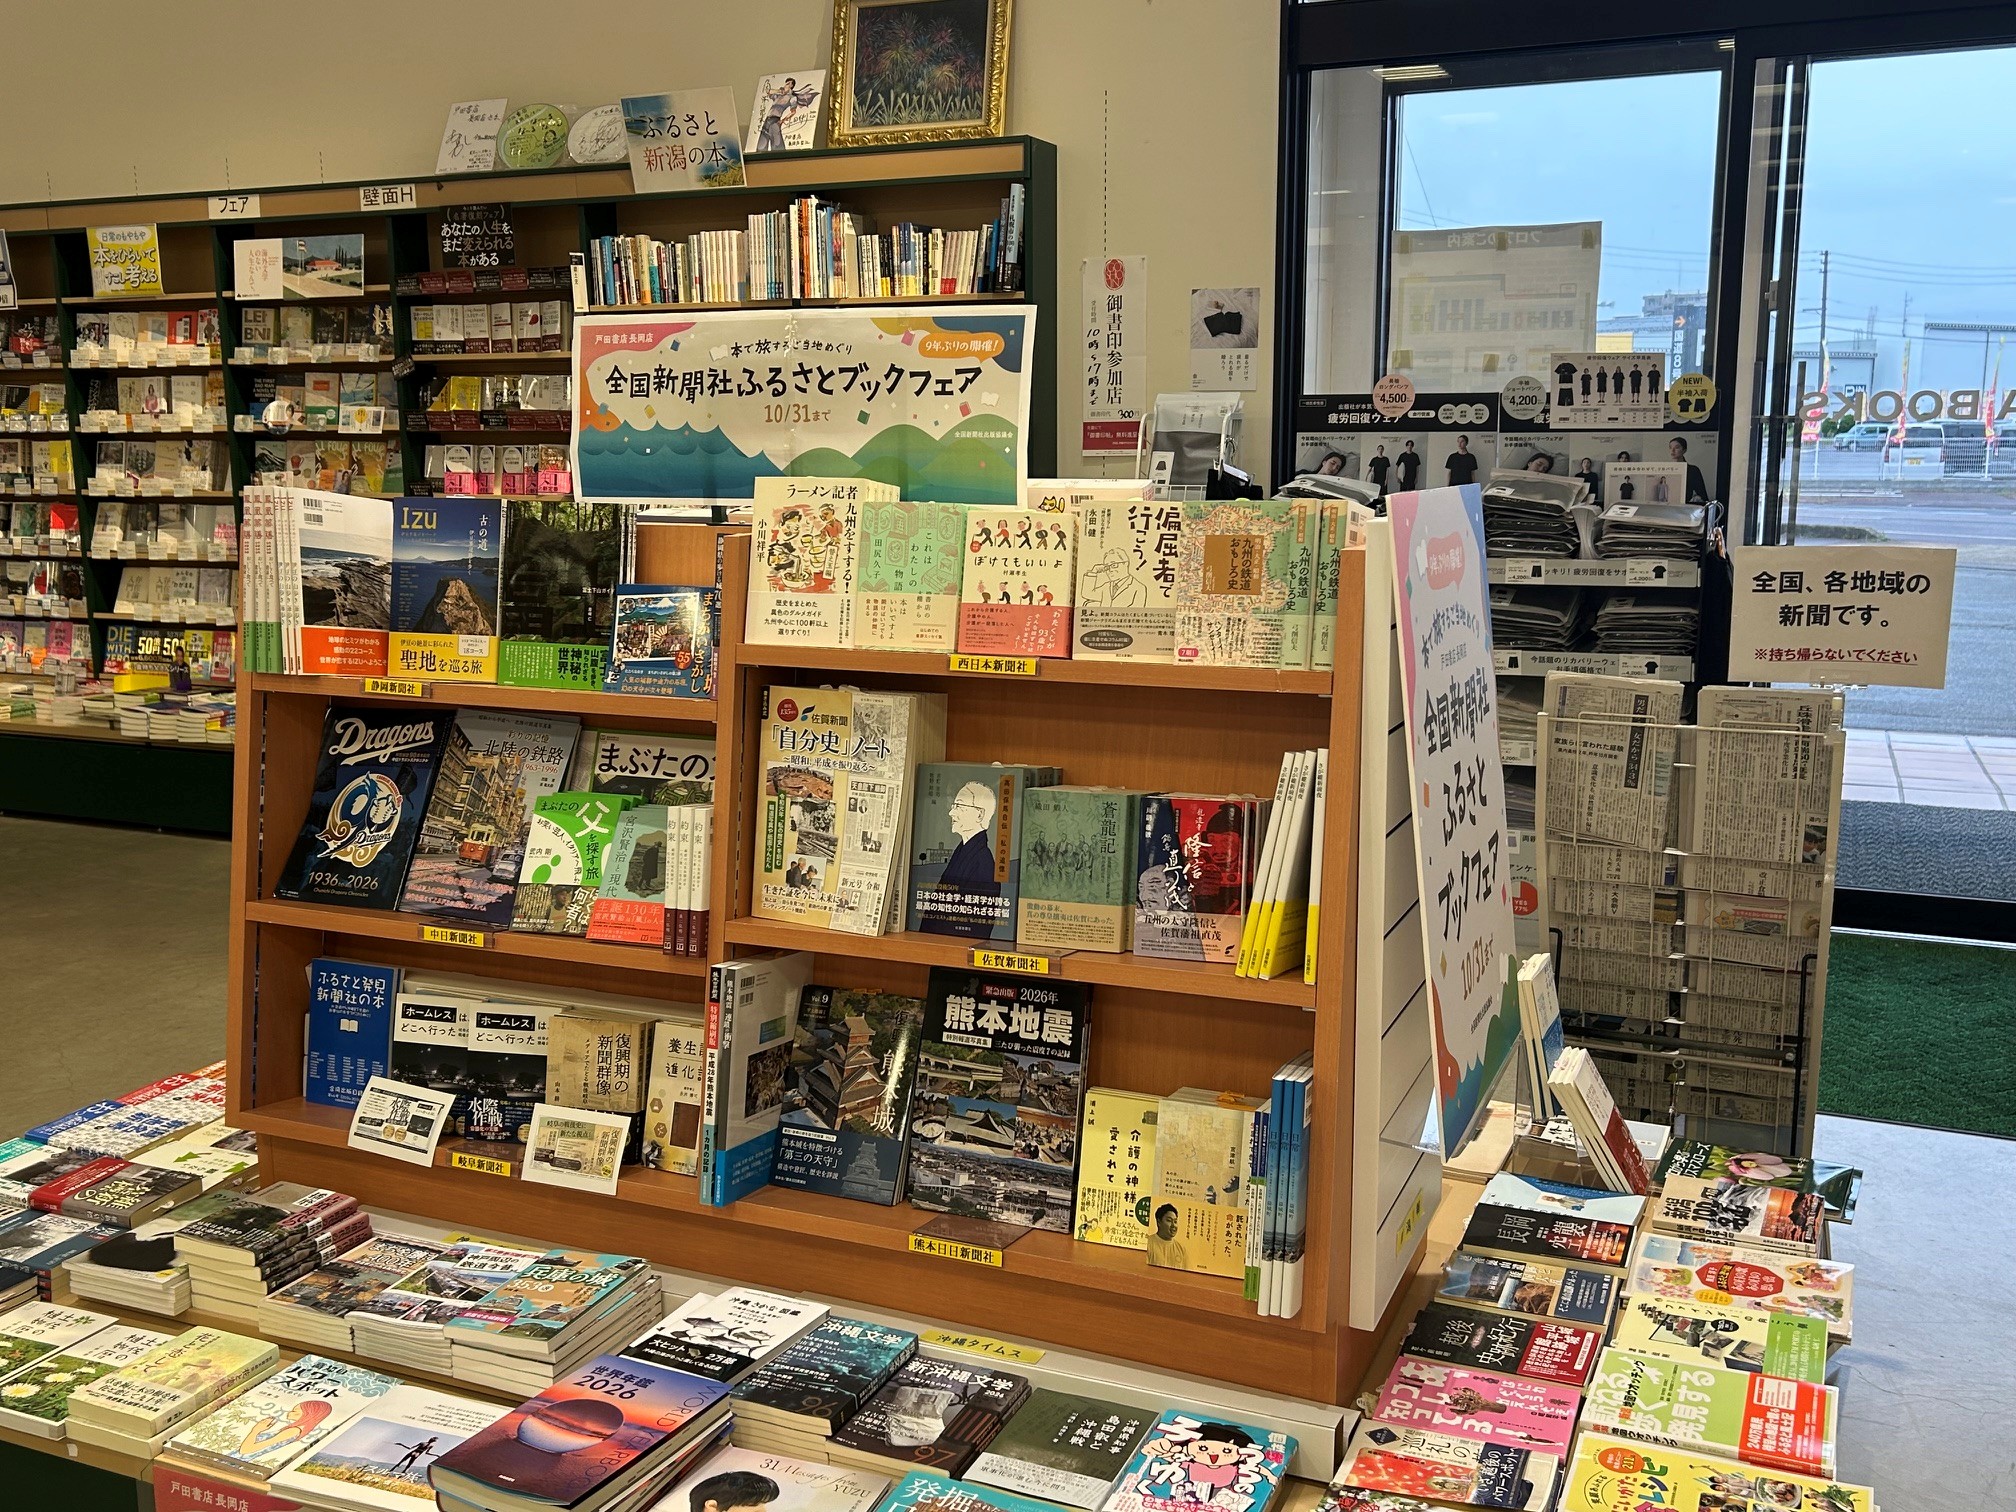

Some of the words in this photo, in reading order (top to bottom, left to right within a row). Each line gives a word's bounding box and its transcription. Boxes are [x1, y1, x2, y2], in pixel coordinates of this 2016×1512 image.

[642, 110, 720, 139] ふるさと
[643, 141, 728, 172] 新潟の本
[218, 196, 249, 213] フェア
[362, 187, 414, 207] 壁面H
[101, 231, 146, 242] 日常のもやもや
[441, 221, 513, 237] あなたの人生を、
[93, 244, 157, 268] 本をひらいて
[442, 236, 514, 253] まだ変えられる
[457, 252, 500, 267] 本がある
[105, 264, 158, 288] すこし考える
[594, 333, 654, 345] 戸田書店長岡店
[731, 338, 853, 358] 本で旅するご当地めぐり
[925, 339, 999, 353] 9年ぶりの開催!
[1106, 294, 1123, 405] 御書印参加店
[605, 364, 983, 404] 全国新聞社ふるさとブックフェア
[1682, 377, 1703, 385] NEW!
[1380, 393, 1407, 404] 4,500
[1509, 395, 1538, 406] 4,200
[1676, 389, 1708, 398] 半袖入荷
[764, 403, 831, 424] 10/31まで
[1328, 412, 1402, 425] 疲労回復ウェア
[954, 431, 1014, 439] 全国新聞社出版協議会
[786, 484, 859, 500] ラーメン記者
[401, 506, 437, 531] Izu
[1088, 509, 1098, 526] 永田
[478, 515, 489, 551] 古の道
[755, 518, 768, 563] 小川祥平
[1087, 528, 1097, 538] 健
[1127, 505, 1153, 572] 行こう!
[842, 502, 859, 594] 九州をすする!
[872, 539, 883, 580] 田尻久子
[923, 531, 933, 565] これは
[1152, 506, 1182, 598] 偏屈者で
[908, 544, 920, 587] わたしの
[974, 556, 1063, 569] ぼけてもいいよ
[1227, 538, 1241, 591] おもしろ史
[1240, 537, 1254, 591] 九州の鉄道
[1297, 546, 1312, 599] 九州の鉄道
[893, 569, 904, 592] 物語
[1285, 561, 1299, 611] おもしろ史
[1316, 562, 1329, 612] おもしろ史
[1752, 570, 1931, 594] 全国、各地域の
[771, 609, 823, 618] 異色のグルメガイド
[775, 600, 818, 608] 歴史をまとめた
[1778, 604, 1889, 628] 新聞です。
[764, 619, 829, 628] 九州中心に100軒以上
[888, 599, 897, 640] いいですよ
[1046, 608, 1063, 650] 「わたくしが
[107, 626, 134, 643] DIE
[328, 636, 380, 646] 地球のヒミツがわかる
[400, 639, 454, 649] 伊豆の絶景に彩られた
[689, 592, 713, 694] まちがいさがし
[777, 628, 811, 637] 選りすぐり!
[1421, 601, 1480, 669] 本で旅するご当地めぐり
[319, 656, 388, 667] 世界が恋するIZUへようこそ
[400, 649, 483, 675] 聖地を巡る旅
[557, 647, 570, 681] 世界へ
[569, 648, 582, 682] 神秘の
[957, 657, 1028, 673] 西日本新聞社
[1754, 647, 1918, 664] ※持ち帰らないでください
[370, 680, 416, 695] 静岡新聞社
[811, 714, 848, 728] 佐賀新聞
[1424, 665, 1491, 757] 全国新聞社
[329, 717, 435, 765] Dragons
[508, 731, 550, 744] 彩りの記憶
[771, 724, 892, 760] 「自分史」ノート
[484, 739, 564, 766] 北陸の鉄路
[783, 756, 877, 773] 〜昭和、平成を振り返る〜
[521, 763, 559, 774] 1963-1996
[540, 801, 579, 812] まぶたの
[1441, 753, 1488, 848] ふるさと
[575, 800, 611, 838] 父
[1100, 801, 1118, 855] 蒼龍記
[585, 833, 599, 880] を探す旅
[605, 815, 638, 898] 宮沢賢治と現代
[308, 871, 339, 888] 1936
[347, 876, 379, 891] 2026
[1438, 829, 1500, 942] ブックフェア
[763, 885, 840, 905] 生きた証を今に、未来に
[916, 890, 1011, 907] 日本の社会学・経済学が誇る
[563, 887, 586, 931] 何者?
[597, 902, 661, 915] 生誕130年
[915, 902, 1010, 918] 最高の知性の知られざる苦悩
[1026, 902, 1064, 914] 激動の幕末、
[1026, 911, 1115, 925] 真の尊皇攘夷は佐賀にあった。
[1144, 914, 1218, 930] 五州の太守隆信と
[430, 929, 478, 945] 中日新聞社
[1160, 928, 1222, 942] 佐賀藩祖直茂
[982, 953, 1041, 971] 佐賀新聞社
[1460, 932, 1495, 1001] 10/31まで
[317, 971, 386, 994] ふるさと発見
[985, 984, 1015, 998] 緊急出版
[316, 986, 386, 1009] 新聞社の本
[1020, 987, 1059, 1005] 2026年
[400, 1023, 457, 1037] どこへ行った
[709, 1005, 718, 1046] 特別縮刷版
[943, 994, 1074, 1046] 熊本地震
[476, 1032, 536, 1046] どこへ行った
[945, 1034, 989, 1047] 特別報道写真集
[994, 1040, 1071, 1060] 三たび襲った震度7の記録
[595, 1034, 614, 1096] 新聞群像
[614, 1032, 632, 1093] 復興期の
[705, 1052, 715, 1117] 平成28年熊本地震
[467, 1096, 499, 1112] 水際
[472, 1110, 504, 1128] 作戦
[545, 1120, 587, 1130] 岐阜の戦後史に
[605, 1129, 617, 1163] 復興期の
[702, 1129, 712, 1173] 1カ月の記録
[782, 1138, 843, 1156] 熊本城を特徴づける
[1270, 1131, 1278, 1150] 日常
[1292, 1131, 1300, 1150] 日常
[457, 1155, 505, 1174] 岐阜新聞社
[780, 1147, 838, 1169] 「第三の天守」
[1105, 1127, 1120, 1184] 愛されて
[1229, 1146, 1237, 1170] 宮津航一
[777, 1162, 839, 1180] 構造や意匠、歴史を詳説
[1123, 1128, 1142, 1219] 介護の神様に
[1223, 1212, 1234, 1258] 命があった。
[1235, 1214, 1243, 1248] 託された
[1495, 1213, 1537, 1244] 長岡
[1548, 1220, 1589, 1252] 空襲
[467, 1253, 520, 1264] 神戸周辺の
[913, 1238, 995, 1264] 熊本日日新聞社
[521, 1265, 619, 1289] 兵庫の城
[14, 1309, 56, 1334] 植物暦
[32, 1314, 77, 1337] 土佐の
[1438, 1319, 1475, 1348] 越後
[93, 1333, 139, 1359] 植物暦
[140, 1331, 212, 1374] 花と恋して
[648, 1338, 686, 1353] 大ヒット
[937, 1333, 1021, 1359] 沖縄タイムス
[1475, 1317, 1529, 1366] 史跡紀行
[213, 1367, 251, 1395] 花と恋して
[278, 1376, 340, 1399] スポット
[573, 1374, 638, 1400] 2026
[591, 1364, 656, 1388] 世界年鑑
[905, 1359, 1014, 1393] 新沖縄文学
[1618, 1360, 1646, 1420] 新潟地図ウオッチング
[656, 1383, 725, 1428] WORLD
[1665, 1369, 1716, 1441] 発見する
[1068, 1419, 1098, 1447] 沖縄戦
[1089, 1414, 1122, 1451] 島田叡と
[1108, 1418, 1141, 1455] 沖縄県知事
[1592, 1423, 1678, 1448] 新潟地図ウオッチング
[1746, 1417, 1764, 1451] 240万県民
[1778, 1412, 1795, 1455] ふるさと風土記
[759, 1457, 779, 1471] 31
[832, 1483, 871, 1498] YUZU
